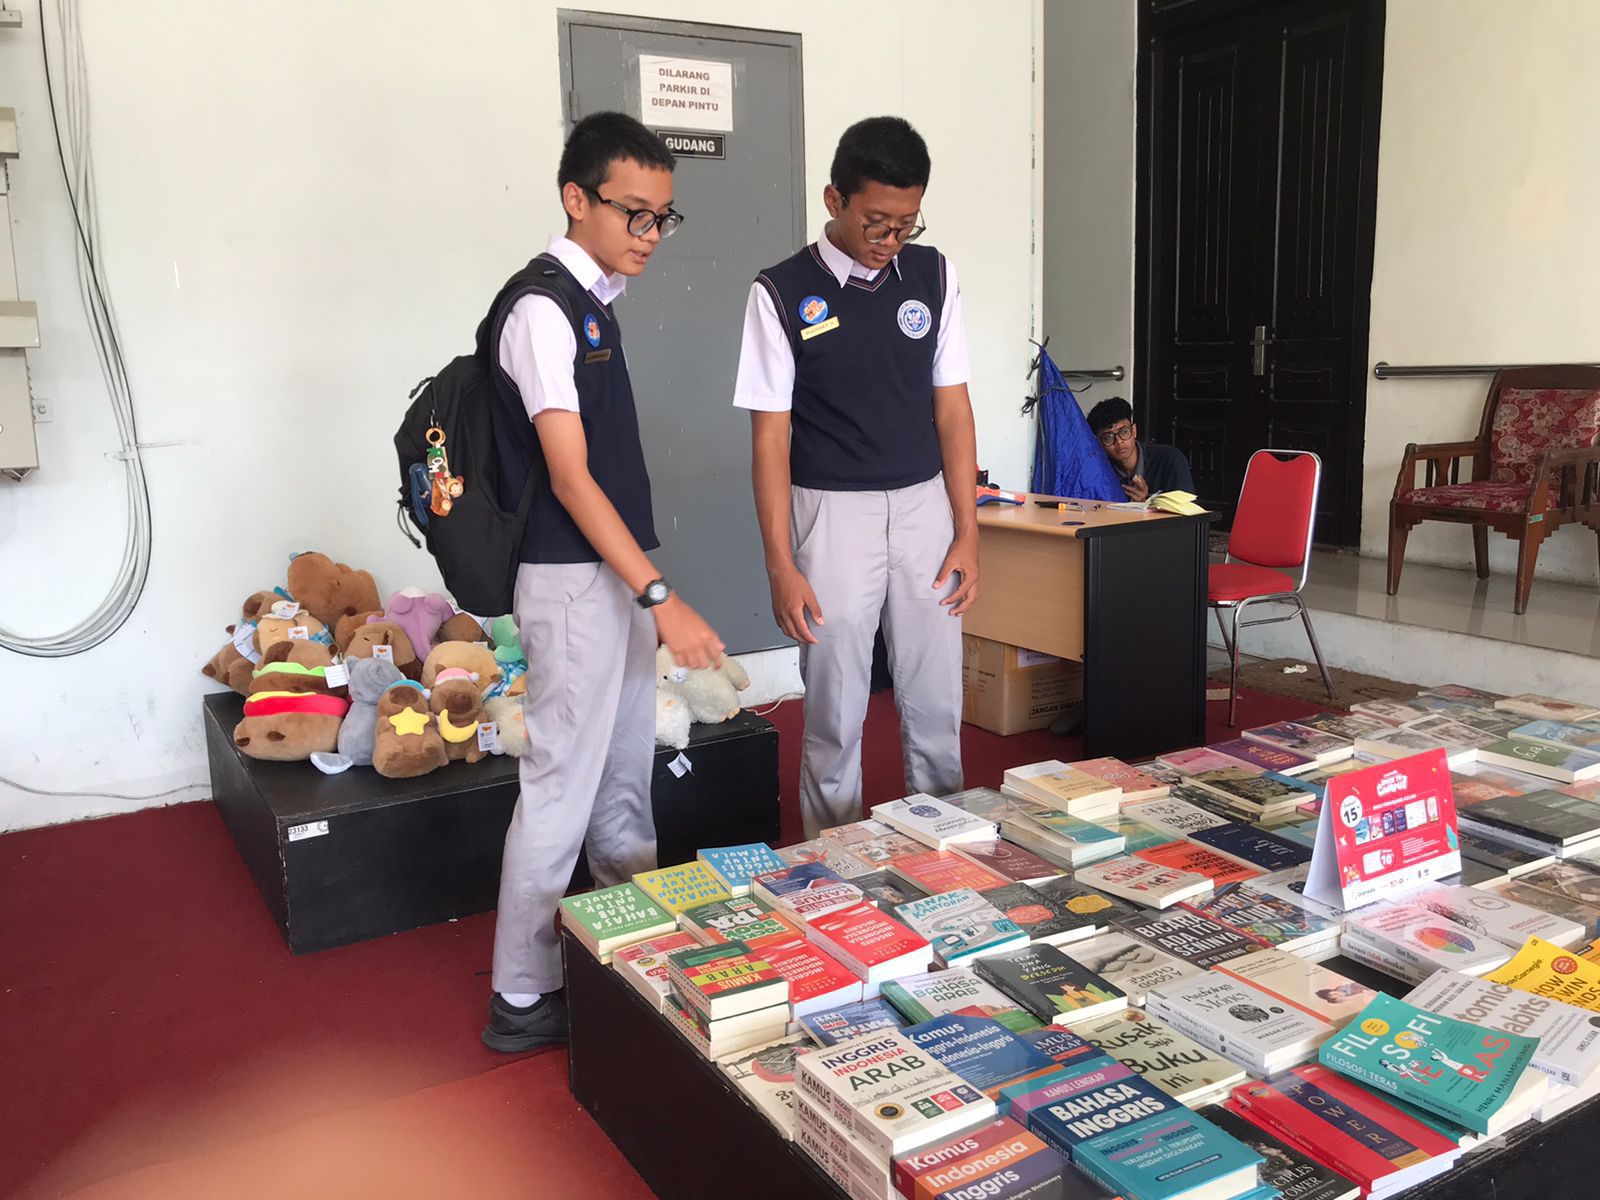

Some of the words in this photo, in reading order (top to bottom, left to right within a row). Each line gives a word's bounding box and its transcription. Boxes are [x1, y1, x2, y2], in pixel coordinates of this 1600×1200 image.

[658, 68, 710, 81] DILARANG
[660, 83, 697, 95] PARKIR
[700, 87, 711, 96] DI
[651, 98, 686, 108] DEPAN
[688, 101, 719, 111] PINTU
[665, 137, 715, 152] GUDANG
[573, 887, 632, 908] PEMULA
[586, 896, 636, 914] UNTUK
[912, 891, 962, 909] ANAK
[912, 895, 970, 919] KANTORAN
[592, 907, 658, 931] BAHASA
[599, 903, 636, 919] ARAB
[1135, 913, 1207, 938] BICARA
[1187, 920, 1222, 936] ITU
[1158, 930, 1199, 949] ADA
[1173, 931, 1244, 956] SENINYA
[705, 964, 754, 980] ARAB
[717, 972, 763, 989] KAMUS
[1138, 974, 1174, 989] GOOD
[912, 978, 982, 999] BAHASA
[933, 987, 980, 1003] ARAB
[1529, 975, 1564, 995] HOW
[1556, 977, 1588, 997] WIN
[1453, 980, 1513, 1023] tomic
[1499, 997, 1550, 1035] abits
[908, 1023, 965, 1044] Kamus
[925, 1025, 1001, 1056] nggris-Indonesia
[1033, 1032, 1073, 1051] MUS
[1089, 1021, 1163, 1051] Rusak
[1144, 1037, 1174, 1049] Saja
[821, 1038, 898, 1070] INGGRIS
[939, 1034, 1015, 1065] ndonesia-Inggris
[1046, 1039, 1082, 1056] GKAP
[832, 1048, 906, 1077] INDONESIA
[1119, 1049, 1208, 1074] Buku
[1326, 1052, 1368, 1076] FILOSOFI
[1368, 1069, 1398, 1091] TERAS
[848, 1055, 926, 1092] ARAB
[1041, 1081, 1072, 1098] KAMUS
[1071, 1072, 1106, 1089] LENGKAP
[1160, 1072, 1194, 1089] Ini
[801, 1070, 832, 1104] KAMUS
[1047, 1083, 1142, 1122] BAHASA
[798, 1099, 828, 1135] KAMUS
[1065, 1096, 1166, 1139] INGGRIS
[801, 1128, 830, 1164] KAMUS
[906, 1137, 980, 1171] Kamus
[925, 1140, 1029, 1189] Indonesia
[1273, 1164, 1314, 1187] CIPLES
[942, 1168, 1021, 1200] Inggris
[1285, 1176, 1323, 1197] OWER
